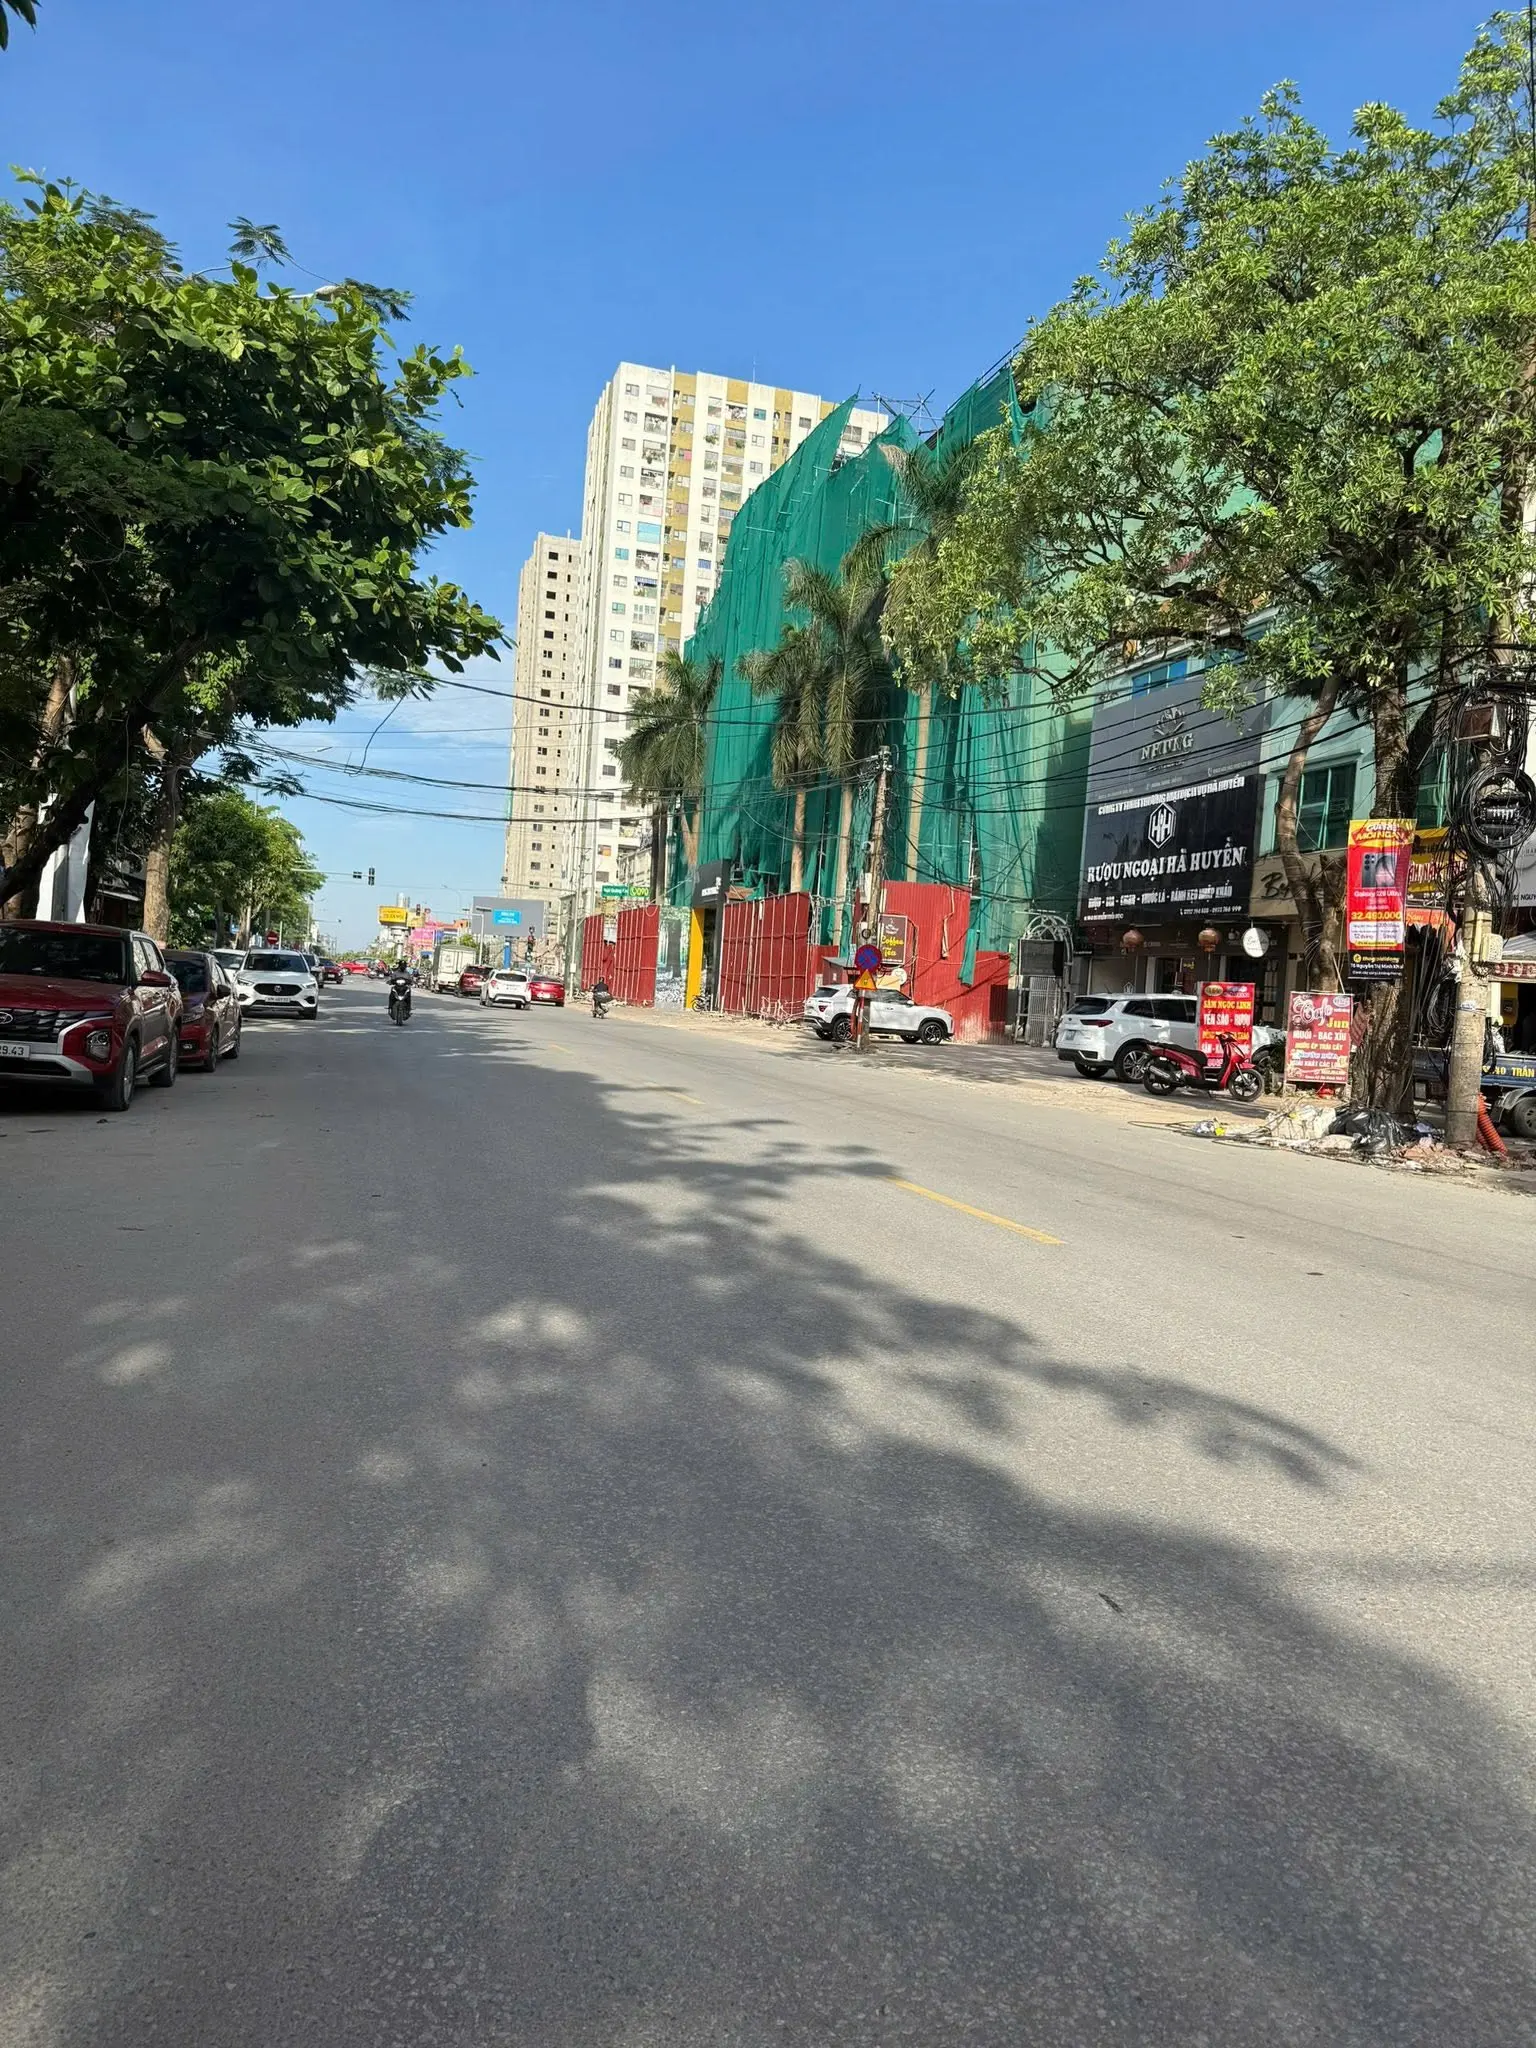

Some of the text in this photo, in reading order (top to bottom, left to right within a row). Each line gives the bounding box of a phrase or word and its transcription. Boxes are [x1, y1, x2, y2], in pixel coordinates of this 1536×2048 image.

[1087, 861, 1121, 886] RƯỢU
[1122, 856, 1164, 881] NGOẠI
[1166, 848, 1186, 873] HÀ
